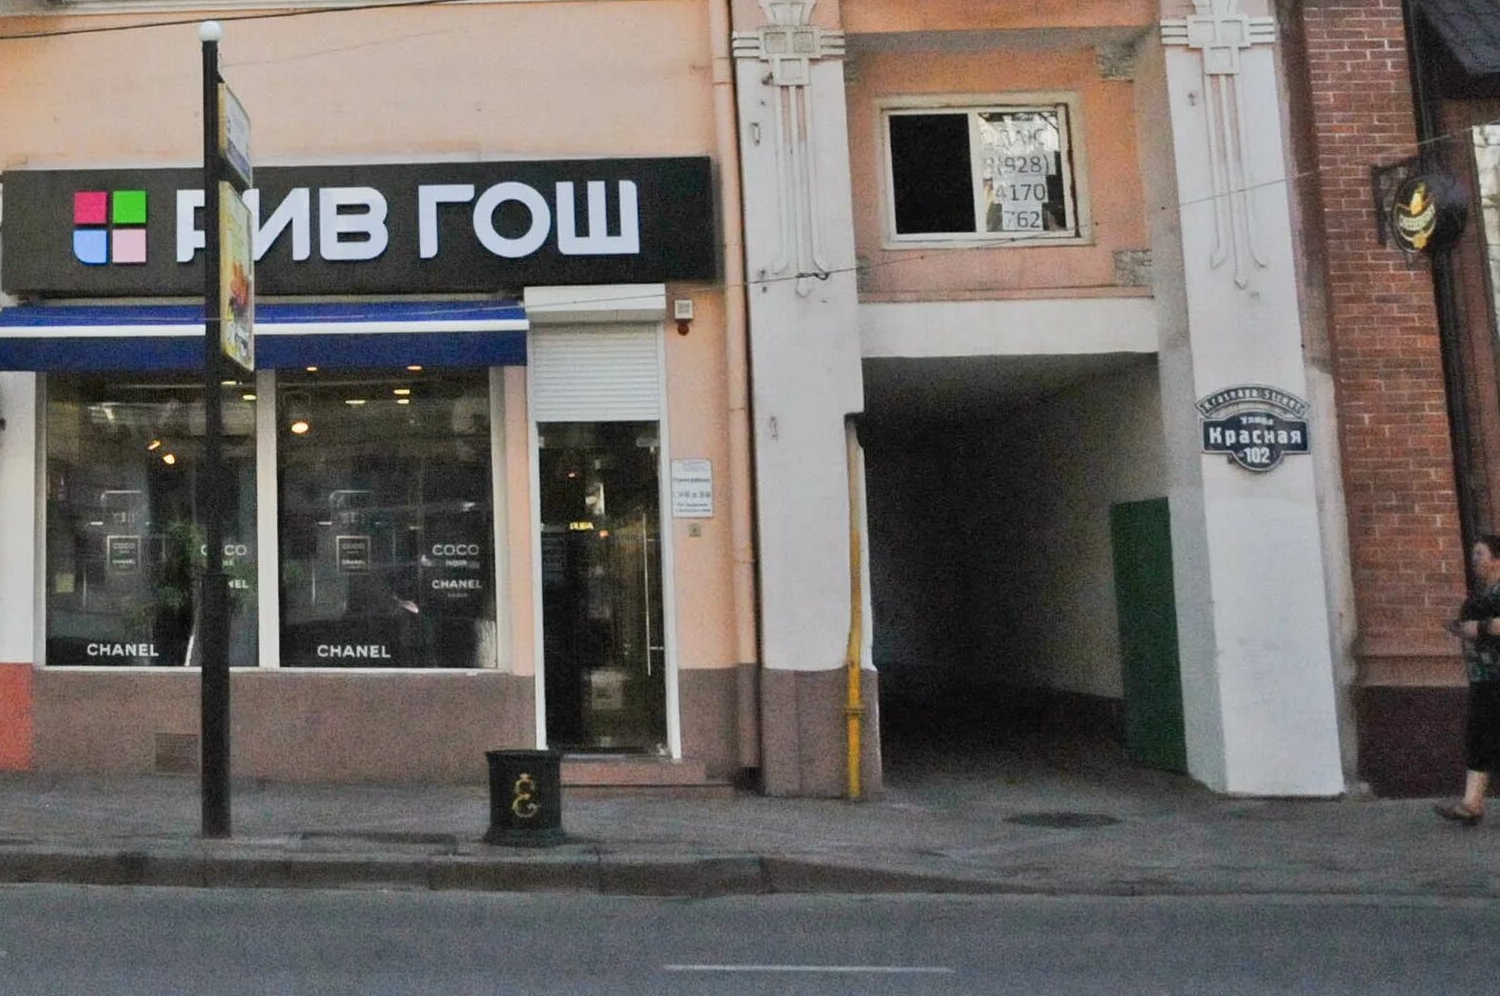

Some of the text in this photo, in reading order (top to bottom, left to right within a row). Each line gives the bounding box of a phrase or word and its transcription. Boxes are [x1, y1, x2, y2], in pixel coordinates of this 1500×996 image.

[995, 184, 1046, 201] 4170
[177, 180, 640, 262] РИВ ГОШ
[1208, 427, 1302, 446] Красная
[1244, 447, 1270, 464] 102
[200, 544, 247, 556] CCO
[432, 544, 480, 556] COCO
[432, 579, 482, 589] CHANEL
[87, 643, 159, 656] CHANEL
[317, 645, 391, 658] CHANEL
